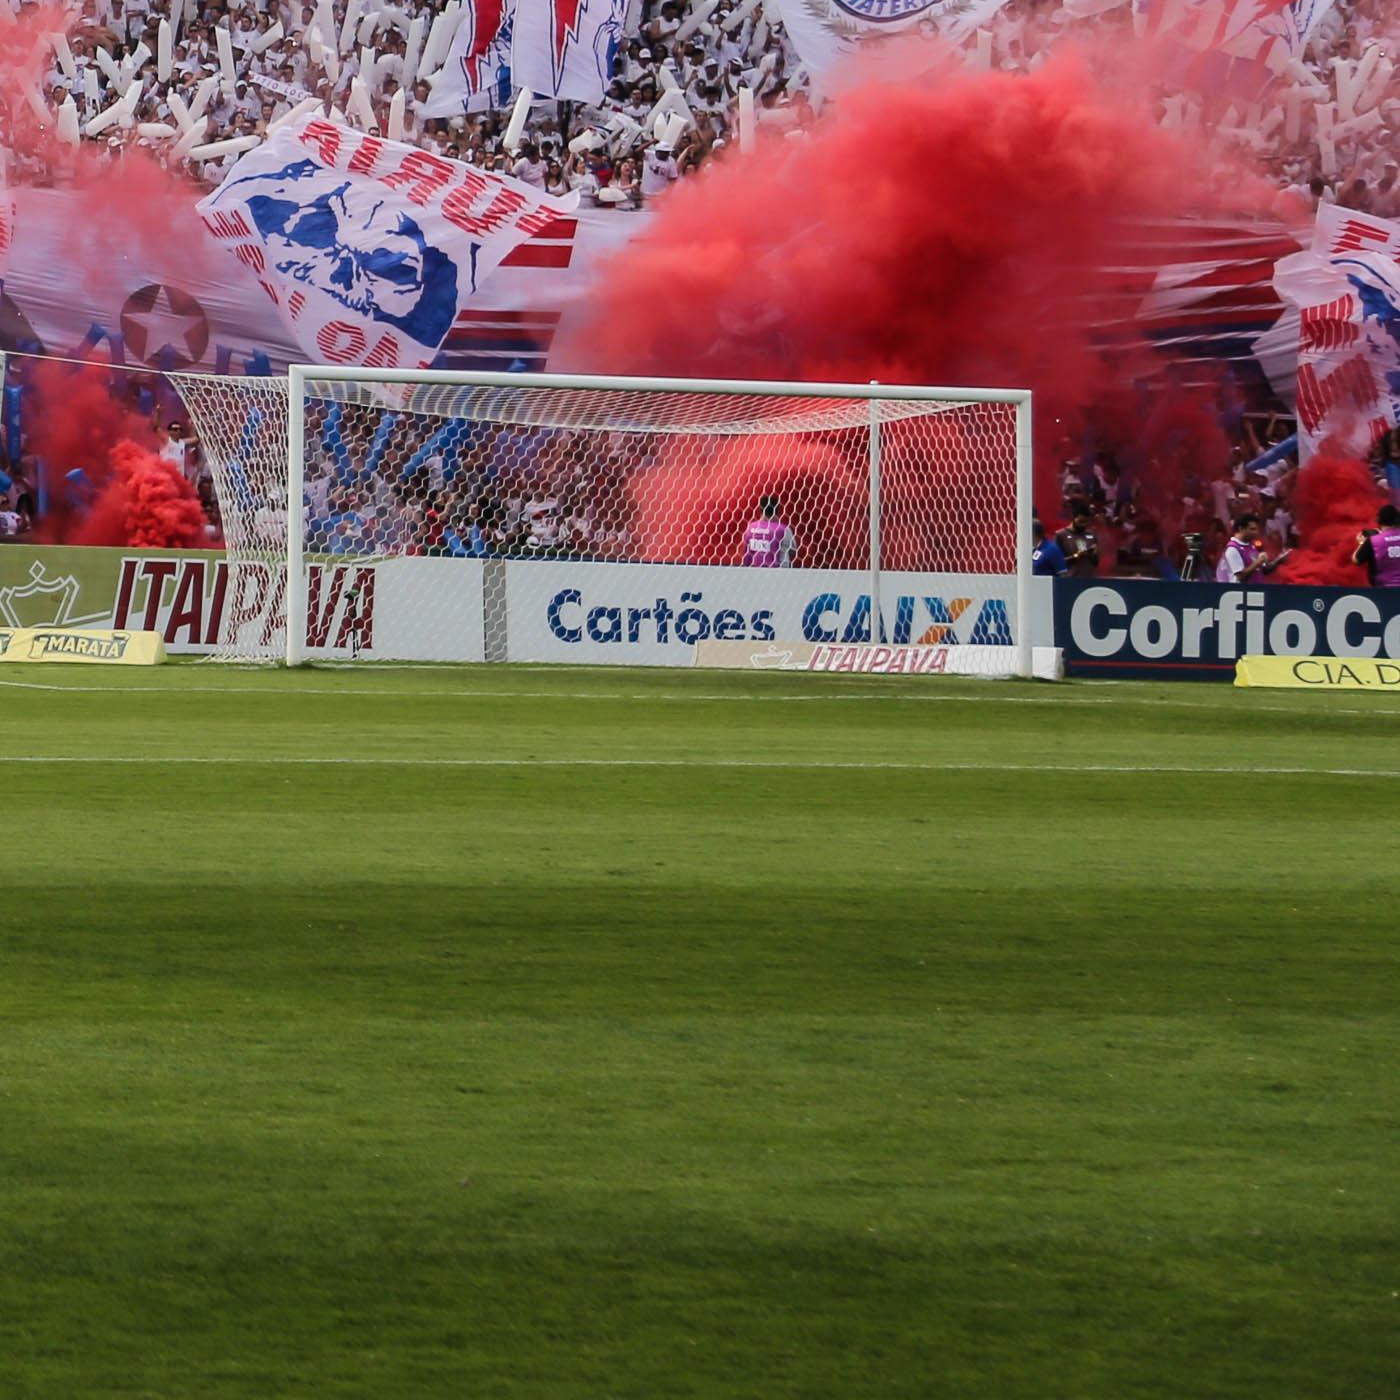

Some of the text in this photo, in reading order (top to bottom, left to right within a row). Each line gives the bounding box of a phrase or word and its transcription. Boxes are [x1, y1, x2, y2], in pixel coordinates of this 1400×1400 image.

[547, 588, 1014, 646] Cartões CAIXA
[807, 646, 949, 673] ITAIPAVA
[1292, 661, 1370, 686] CIA.
